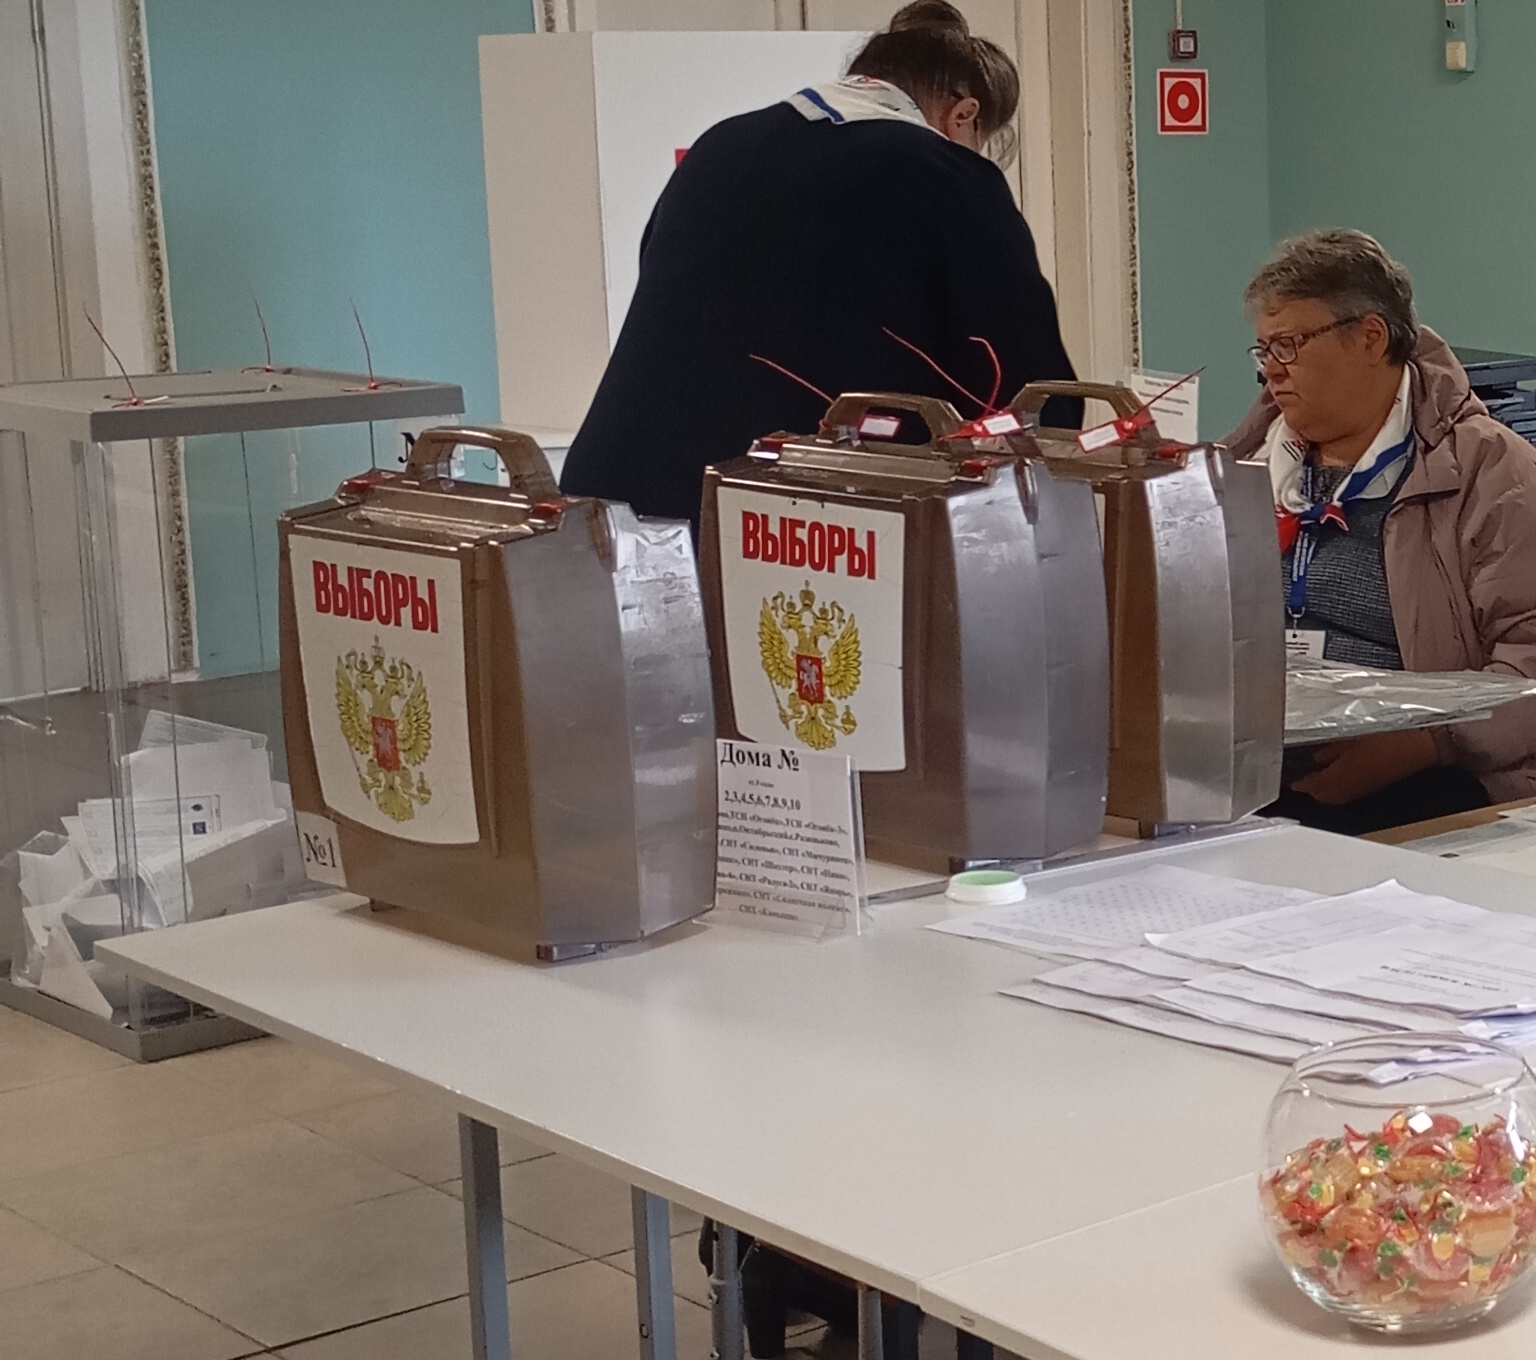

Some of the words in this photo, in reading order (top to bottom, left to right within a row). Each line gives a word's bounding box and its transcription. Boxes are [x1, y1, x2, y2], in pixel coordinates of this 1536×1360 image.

[741, 509, 877, 581] ВЫБОРЫ
[312, 559, 440, 635] ВЫБОРЫ
[720, 742, 772, 769] Дома
[777, 748, 800, 772] №
[304, 830, 337, 870] №1
